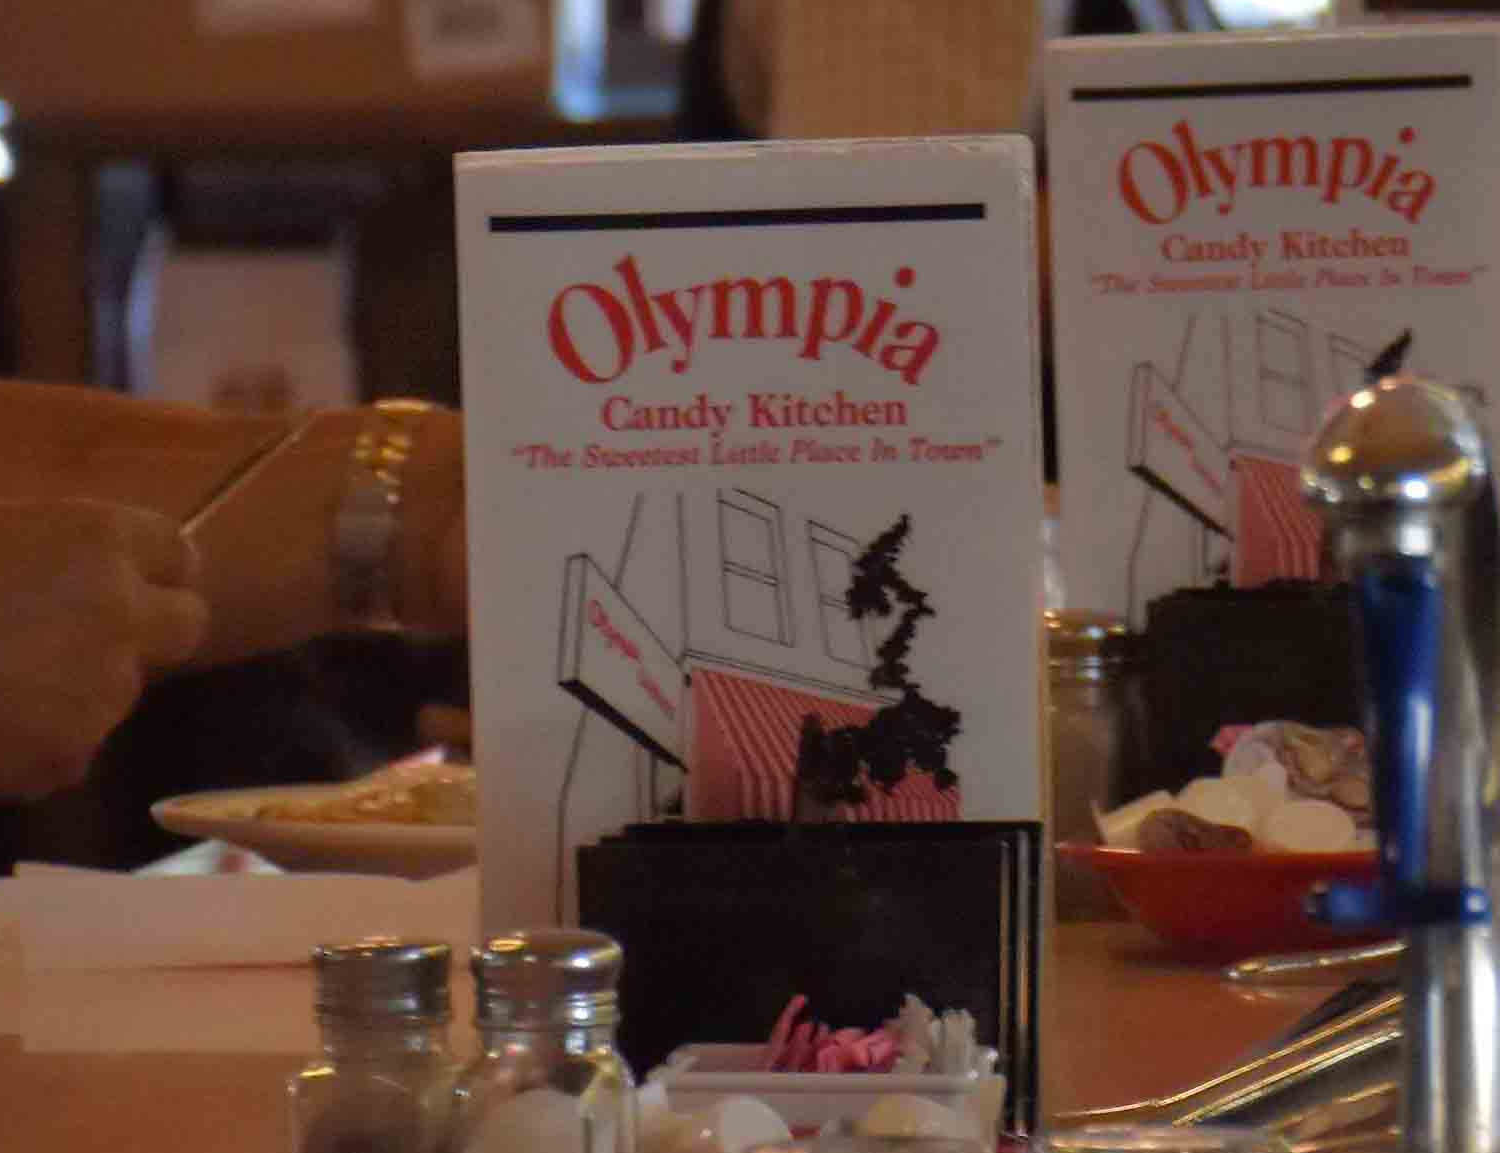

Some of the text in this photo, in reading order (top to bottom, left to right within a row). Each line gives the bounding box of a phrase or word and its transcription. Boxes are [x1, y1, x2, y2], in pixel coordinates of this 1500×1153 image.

[1118, 118, 1438, 227] Olympia
[1160, 227, 1412, 268] Candy Kitchen
[547, 253, 940, 386] Olympia
[599, 390, 908, 439] Candy Kitchen
[581, 442, 699, 468] Sweetest
[706, 439, 781, 467] Little
[788, 438, 862, 465] Place
[868, 436, 901, 463] In
